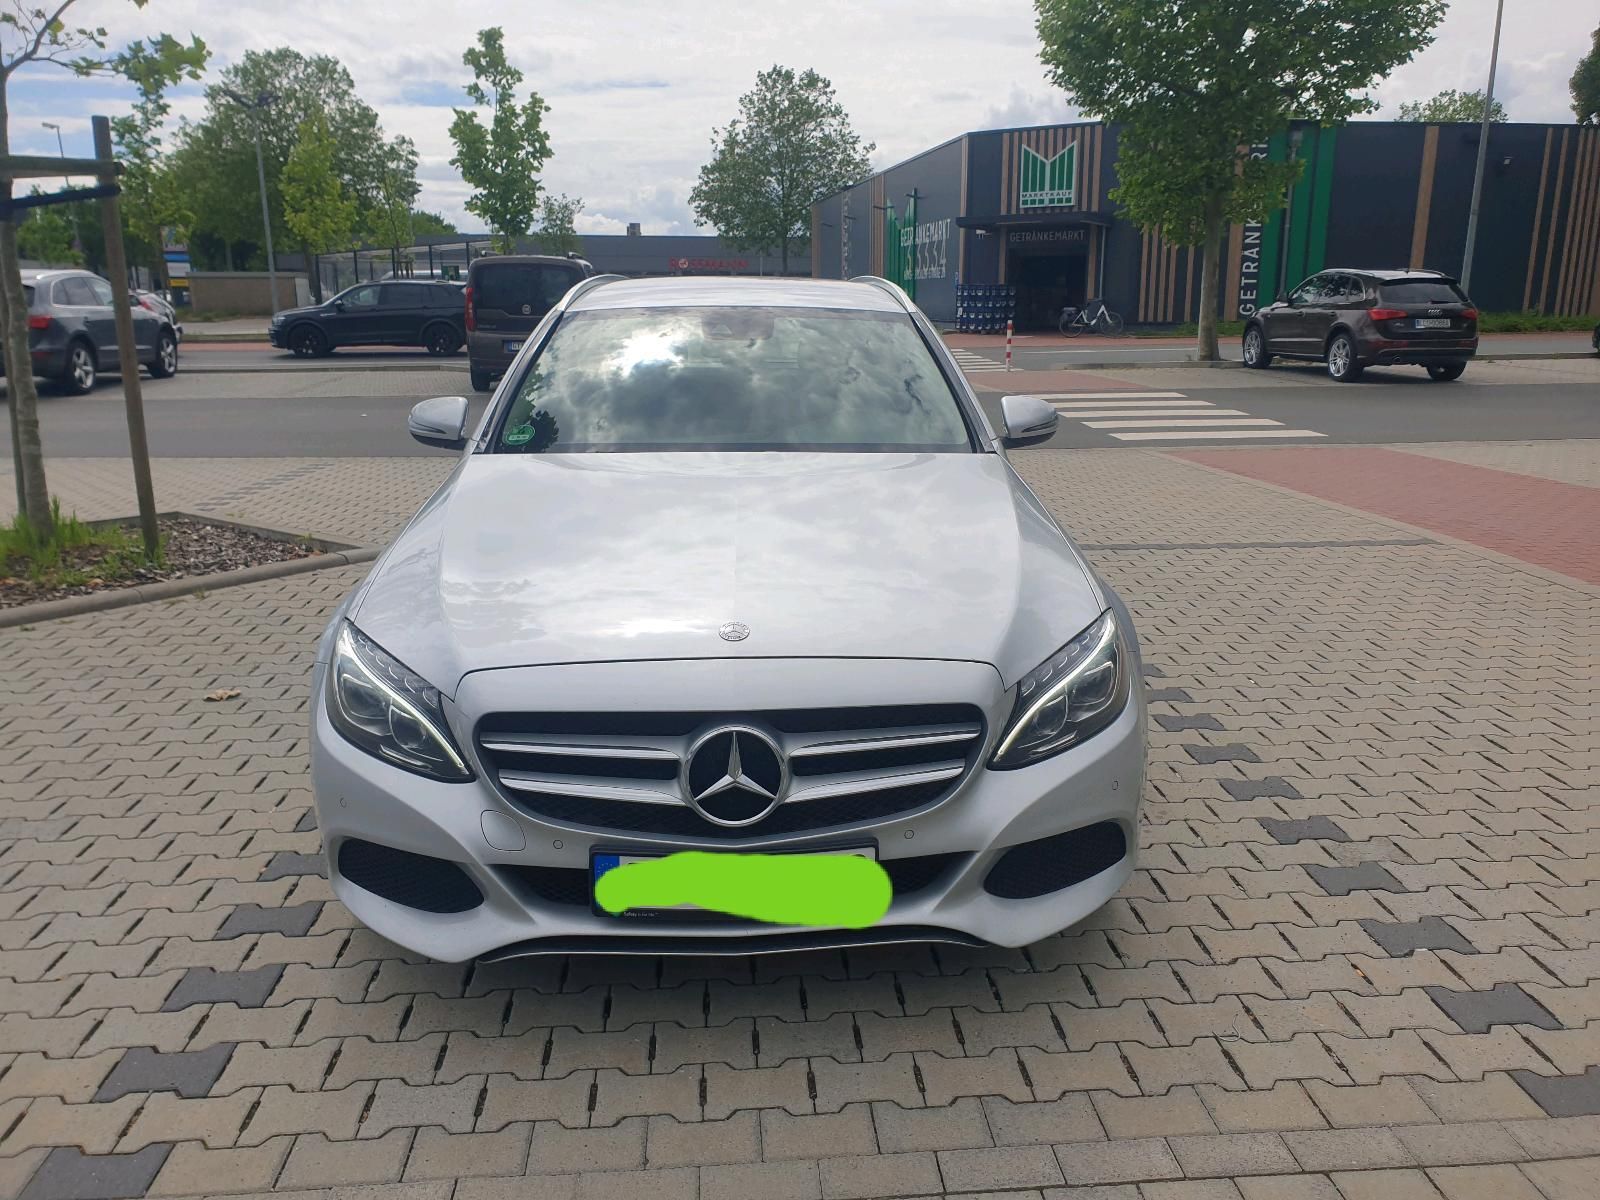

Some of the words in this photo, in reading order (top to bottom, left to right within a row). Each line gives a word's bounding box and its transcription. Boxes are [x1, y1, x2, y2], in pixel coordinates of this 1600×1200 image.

[1021, 191, 1073, 199] MARKTKAUF
[901, 218, 950, 246] GETRÄNKEMARKT
[1010, 230, 1085, 242] GETRÄNKEMARKT
